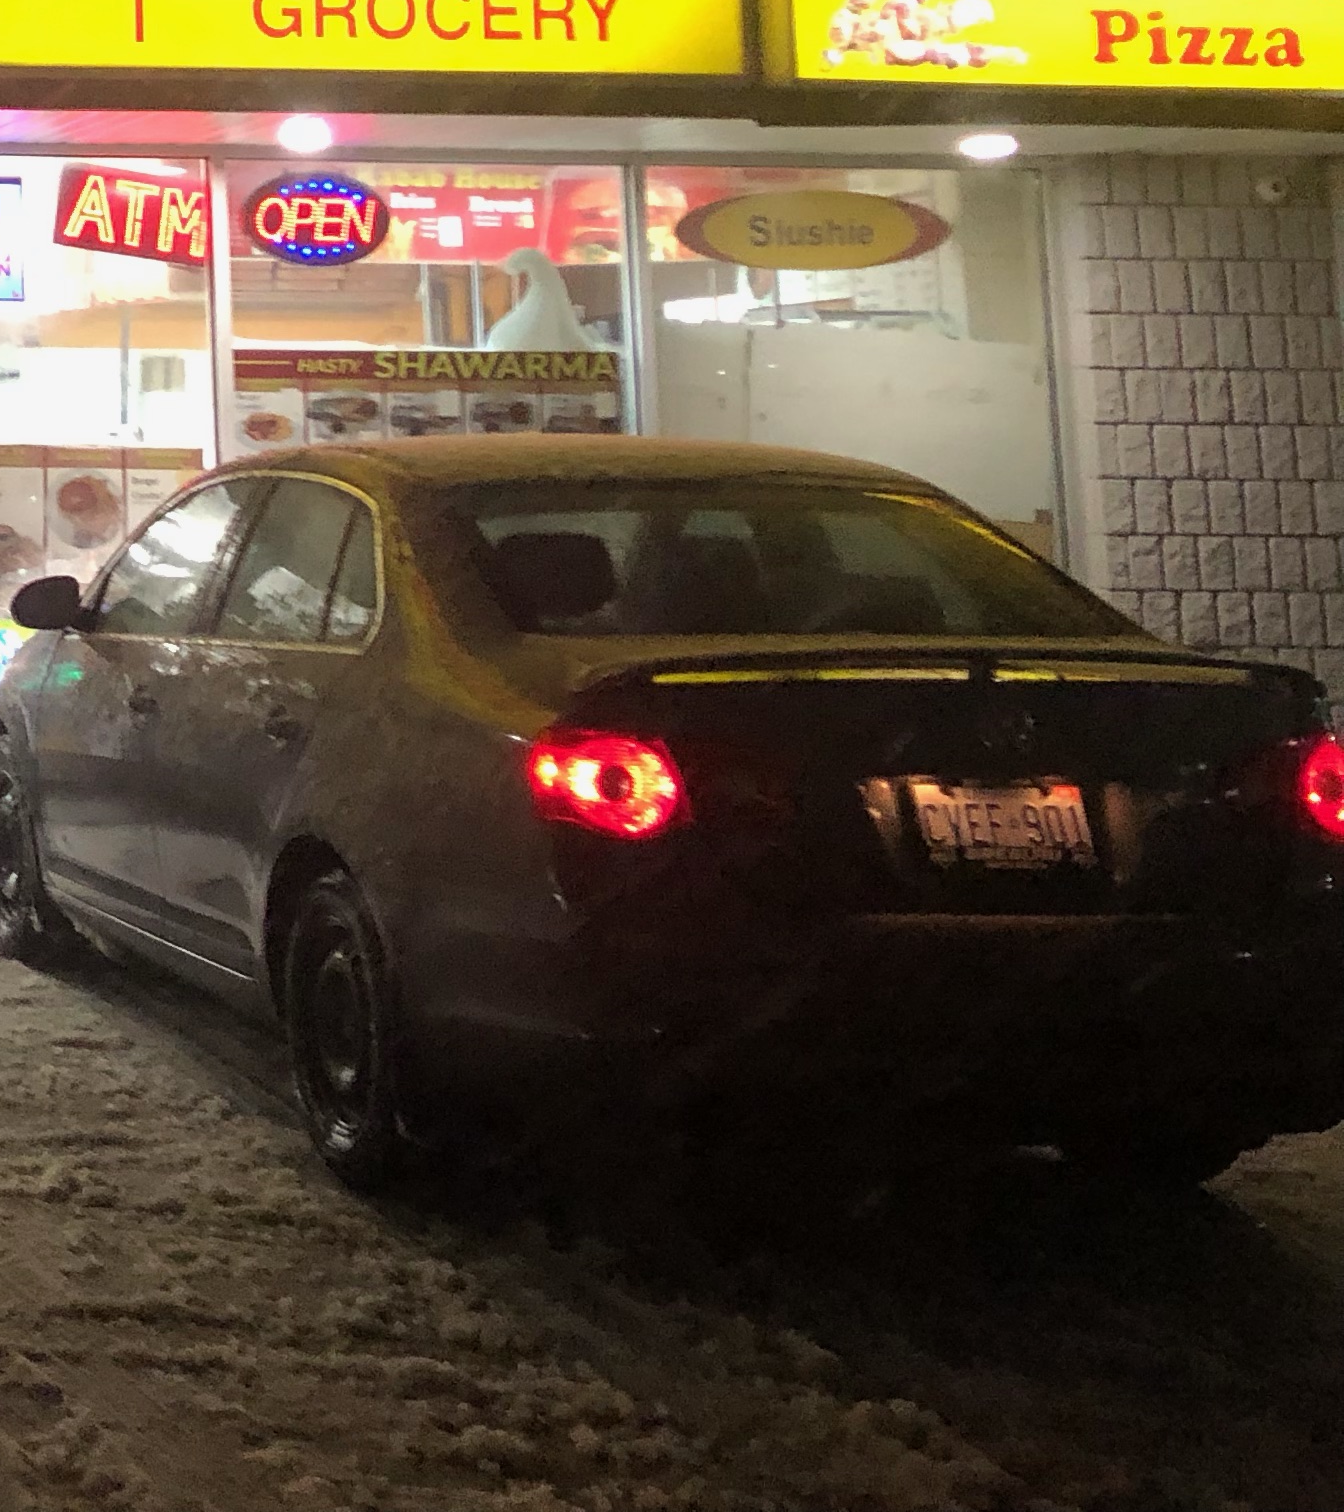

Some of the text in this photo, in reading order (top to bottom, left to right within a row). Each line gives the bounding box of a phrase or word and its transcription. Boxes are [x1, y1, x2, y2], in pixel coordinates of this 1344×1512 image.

[1091, 9, 1305, 67] Pizza
[64, 175, 205, 258] ATM
[256, 196, 376, 243] OPEN
[748, 215, 874, 247] Slushie
[297, 351, 617, 381] HASTY SHAWARMA
